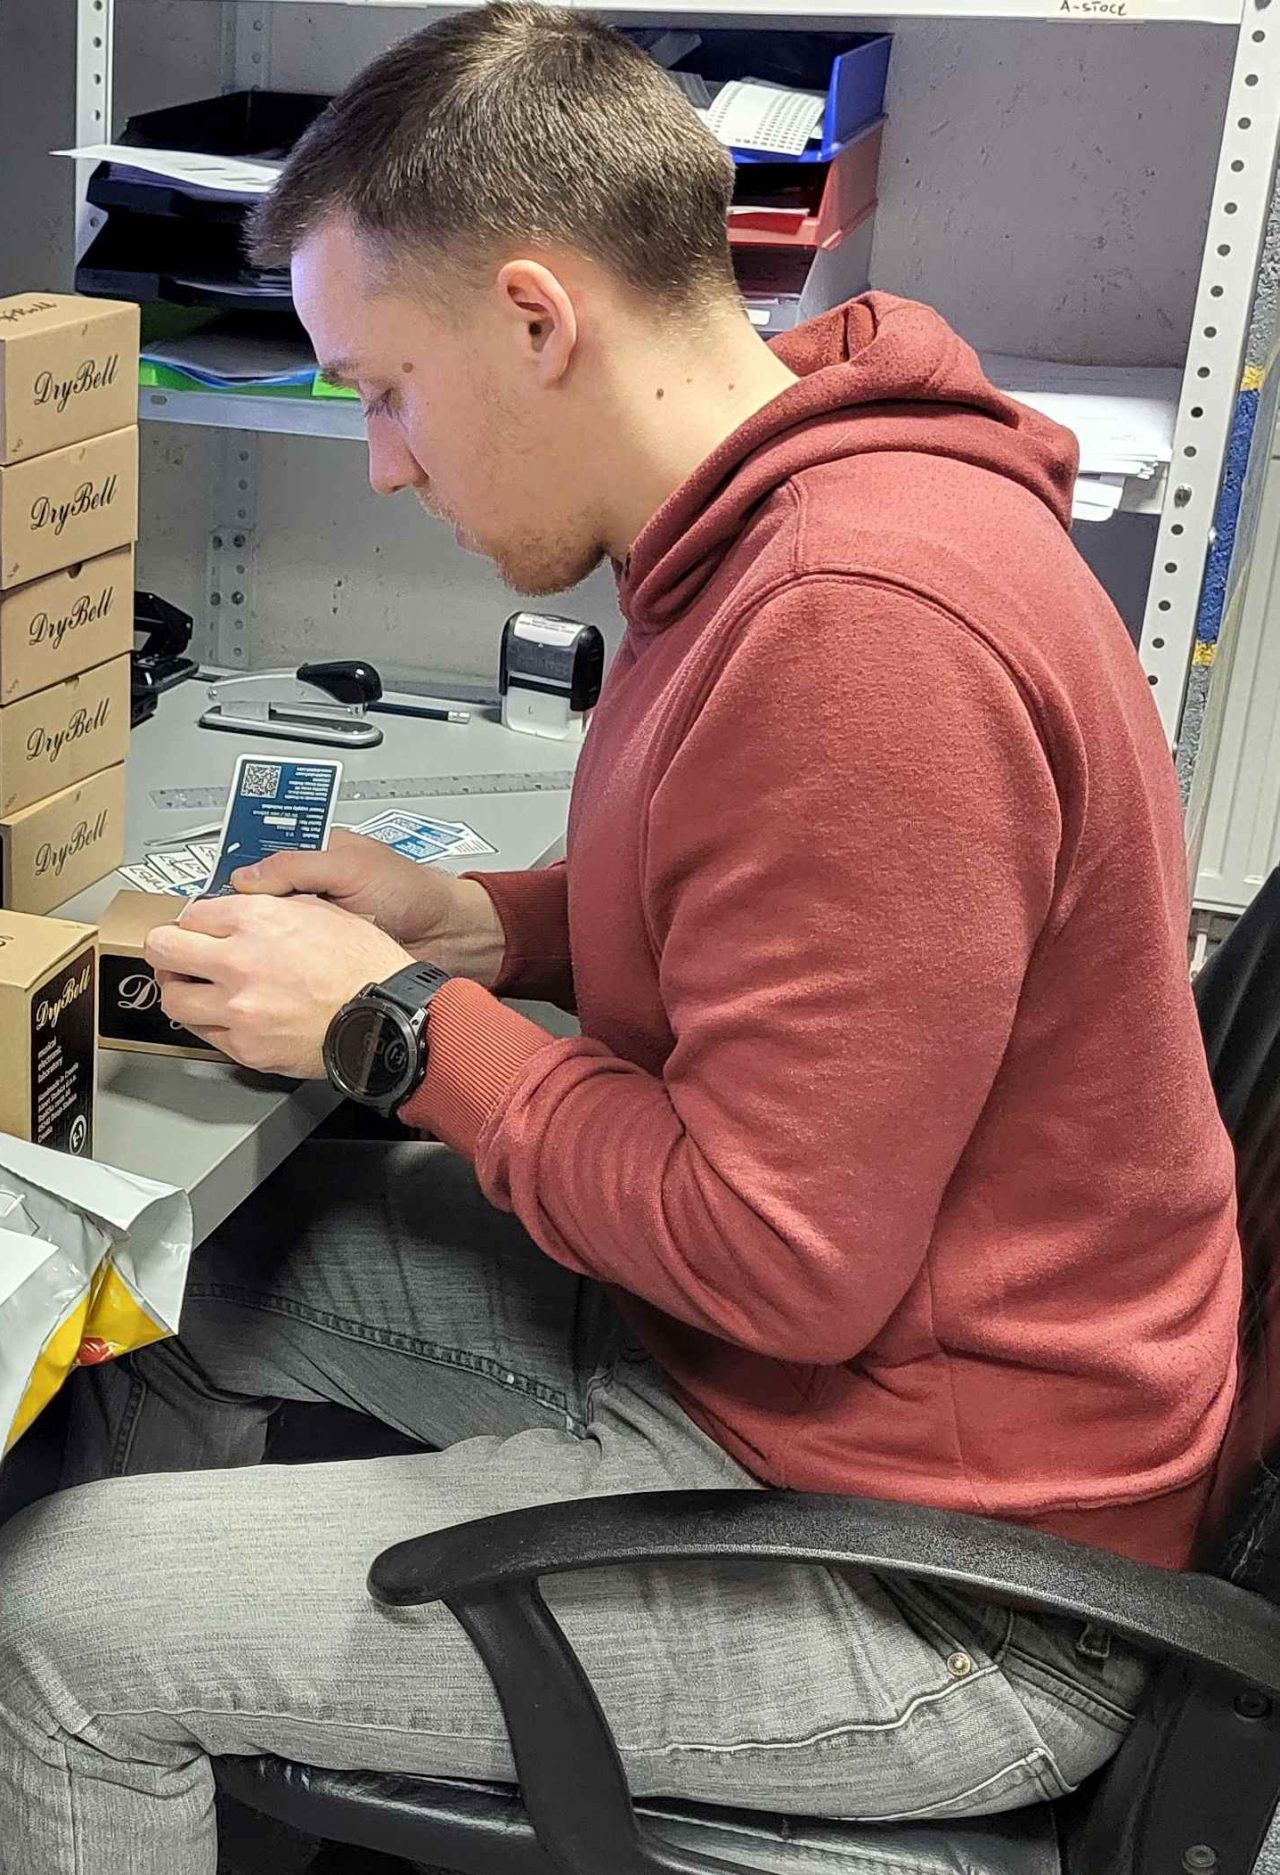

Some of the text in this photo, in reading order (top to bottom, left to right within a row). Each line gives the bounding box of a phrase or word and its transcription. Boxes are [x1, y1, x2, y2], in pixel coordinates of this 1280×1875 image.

[33, 354, 120, 413] DryBell
[30, 474, 117, 536] DryBell
[29, 587, 114, 650] DryBell
[26, 698, 110, 763] DryBell
[34, 808, 109, 878] DryBell
[36, 964, 91, 1031] DryBell
